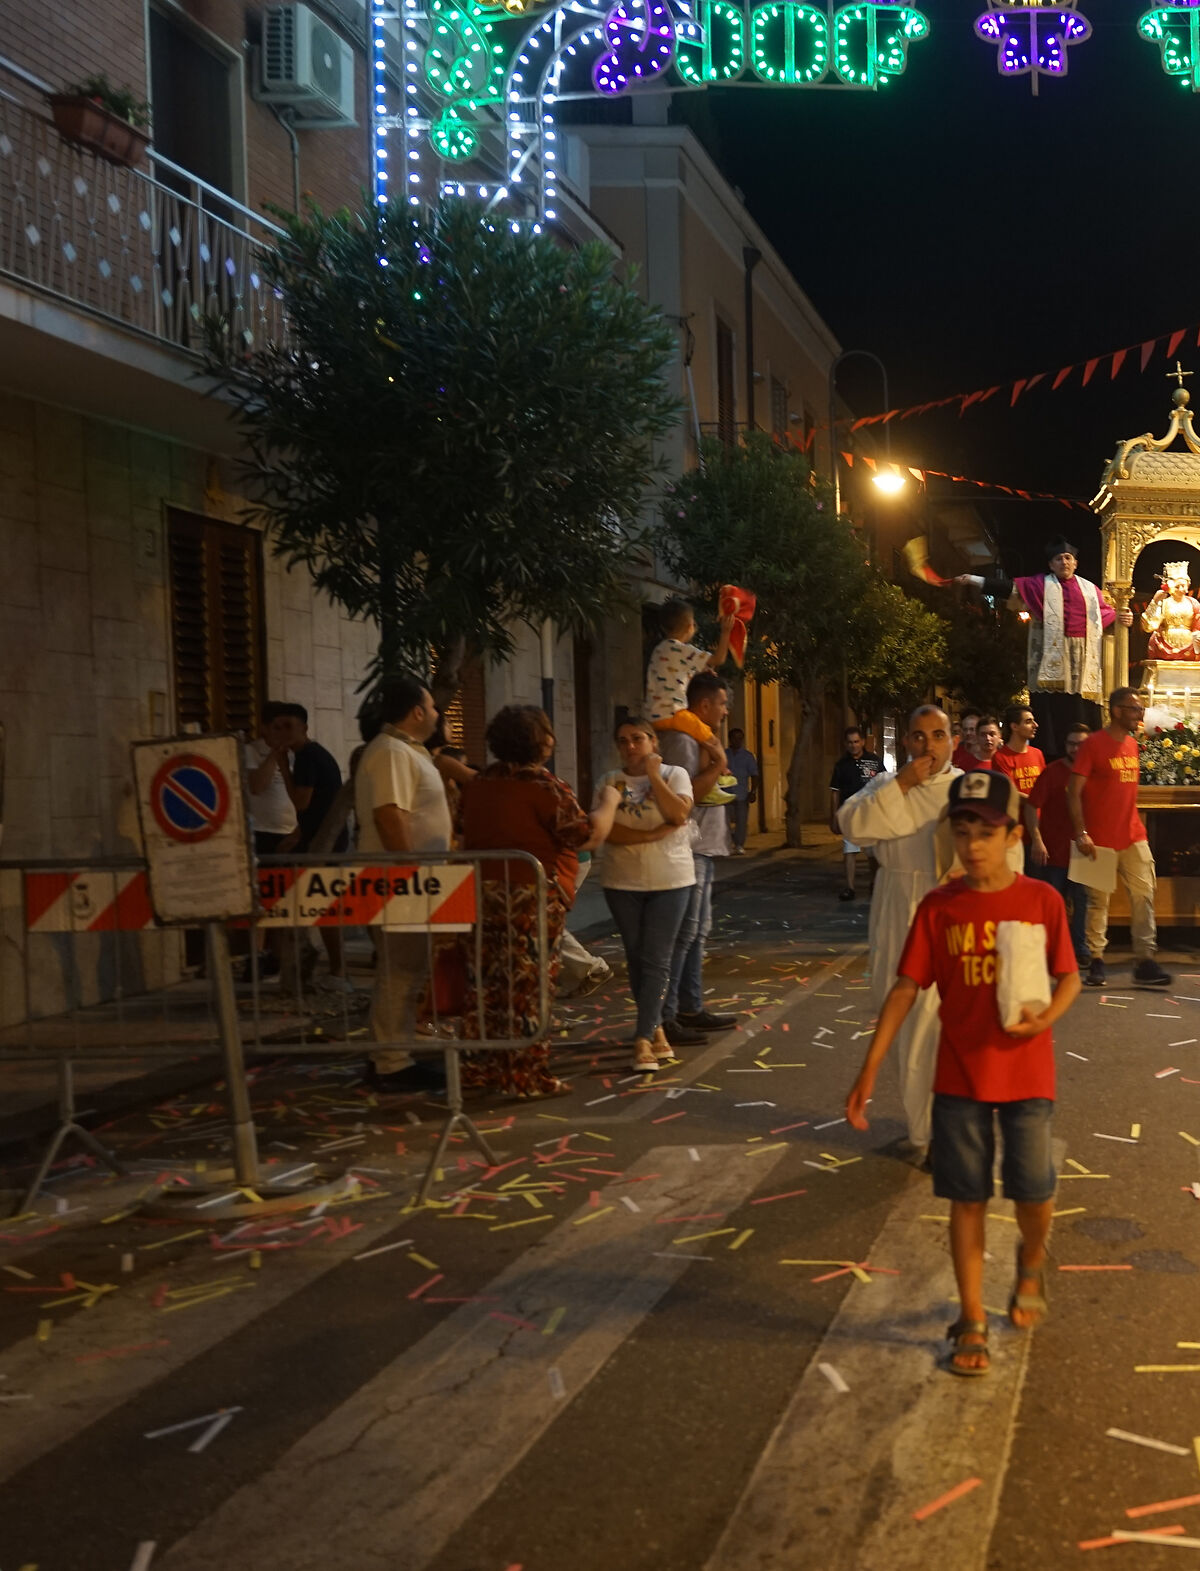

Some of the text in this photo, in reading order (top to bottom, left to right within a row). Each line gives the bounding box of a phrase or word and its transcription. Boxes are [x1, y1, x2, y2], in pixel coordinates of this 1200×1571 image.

[260, 873, 286, 898] di
[306, 871, 441, 898] Acireale
[961, 954, 998, 987] TEC
